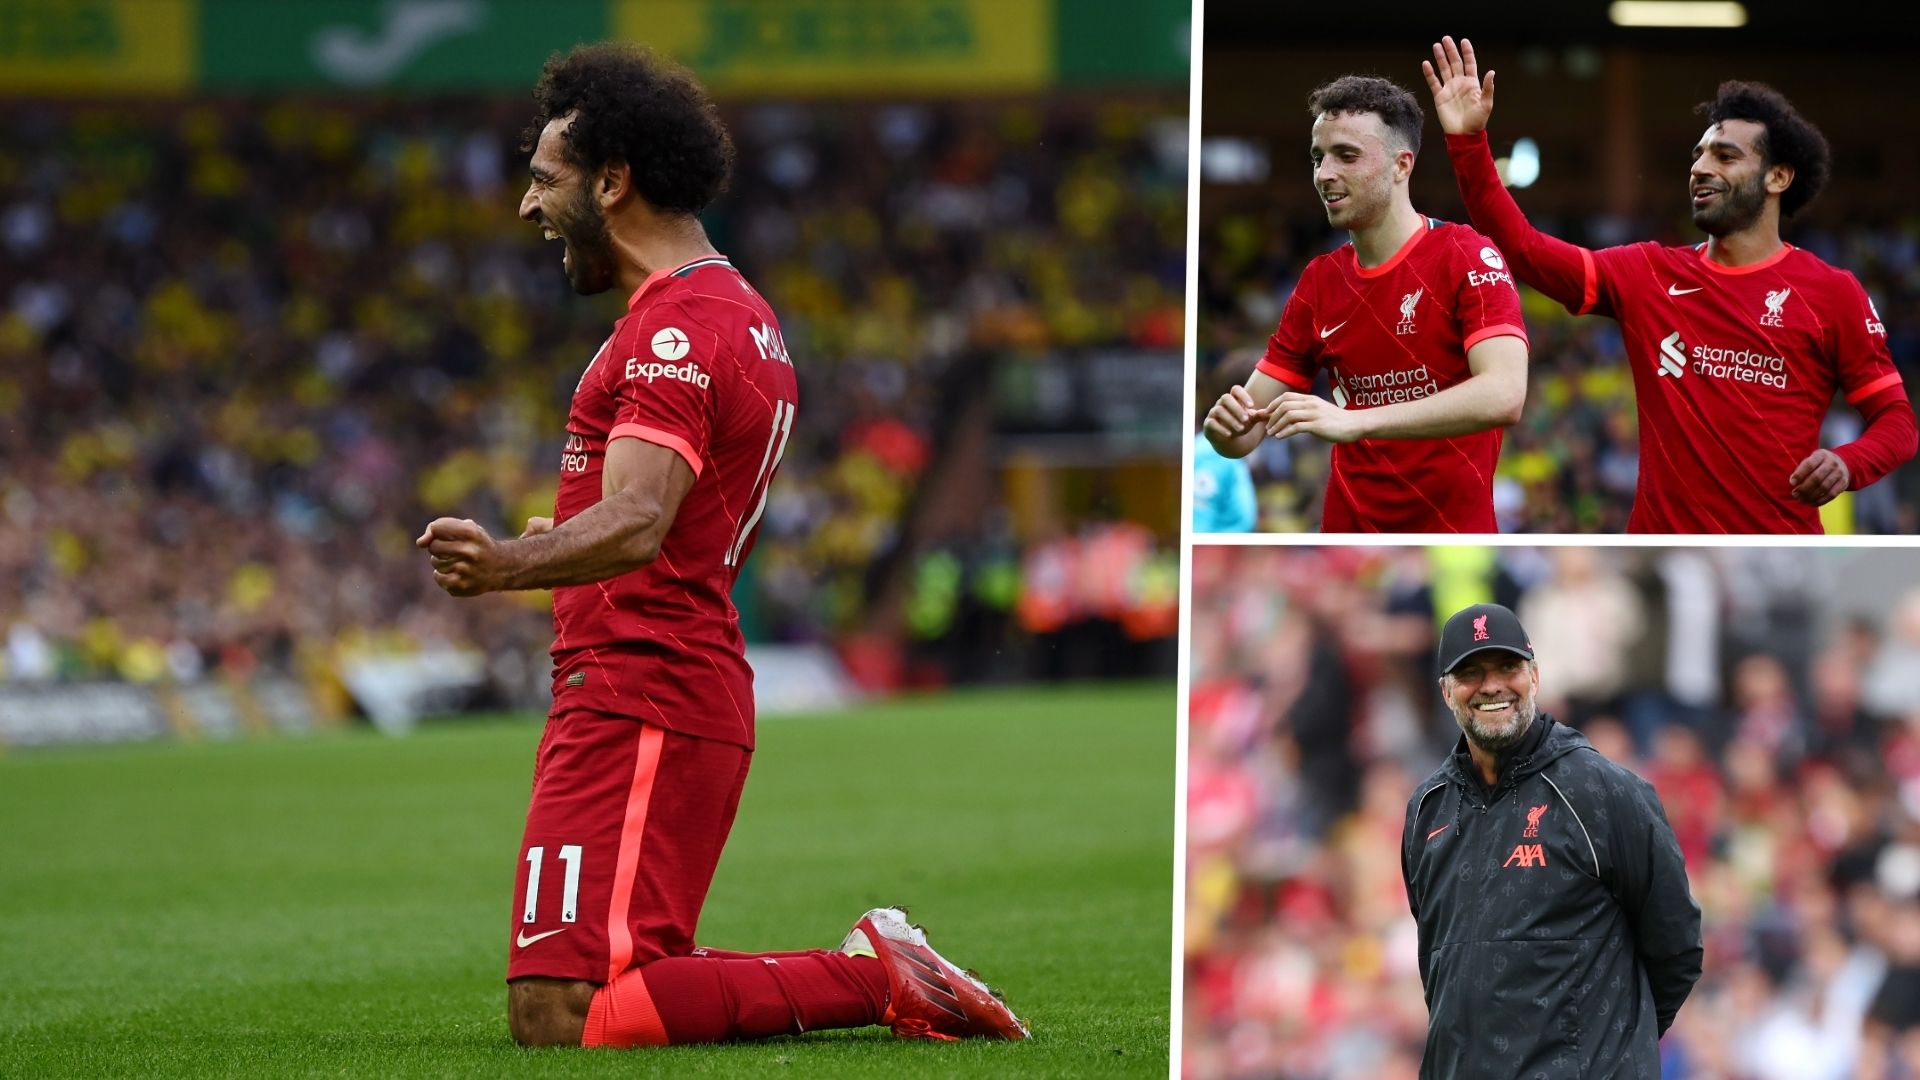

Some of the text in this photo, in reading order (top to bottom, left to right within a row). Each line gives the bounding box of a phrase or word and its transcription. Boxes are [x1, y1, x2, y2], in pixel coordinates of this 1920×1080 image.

[1692, 344, 1785, 373] standard
[625, 357, 711, 390] Expedia
[1349, 363, 1429, 391] standard
[1692, 360, 1788, 390] chartered
[1355, 379, 1439, 407] chartered
[1503, 844, 1548, 868] AXA
[523, 845, 583, 924] 11
